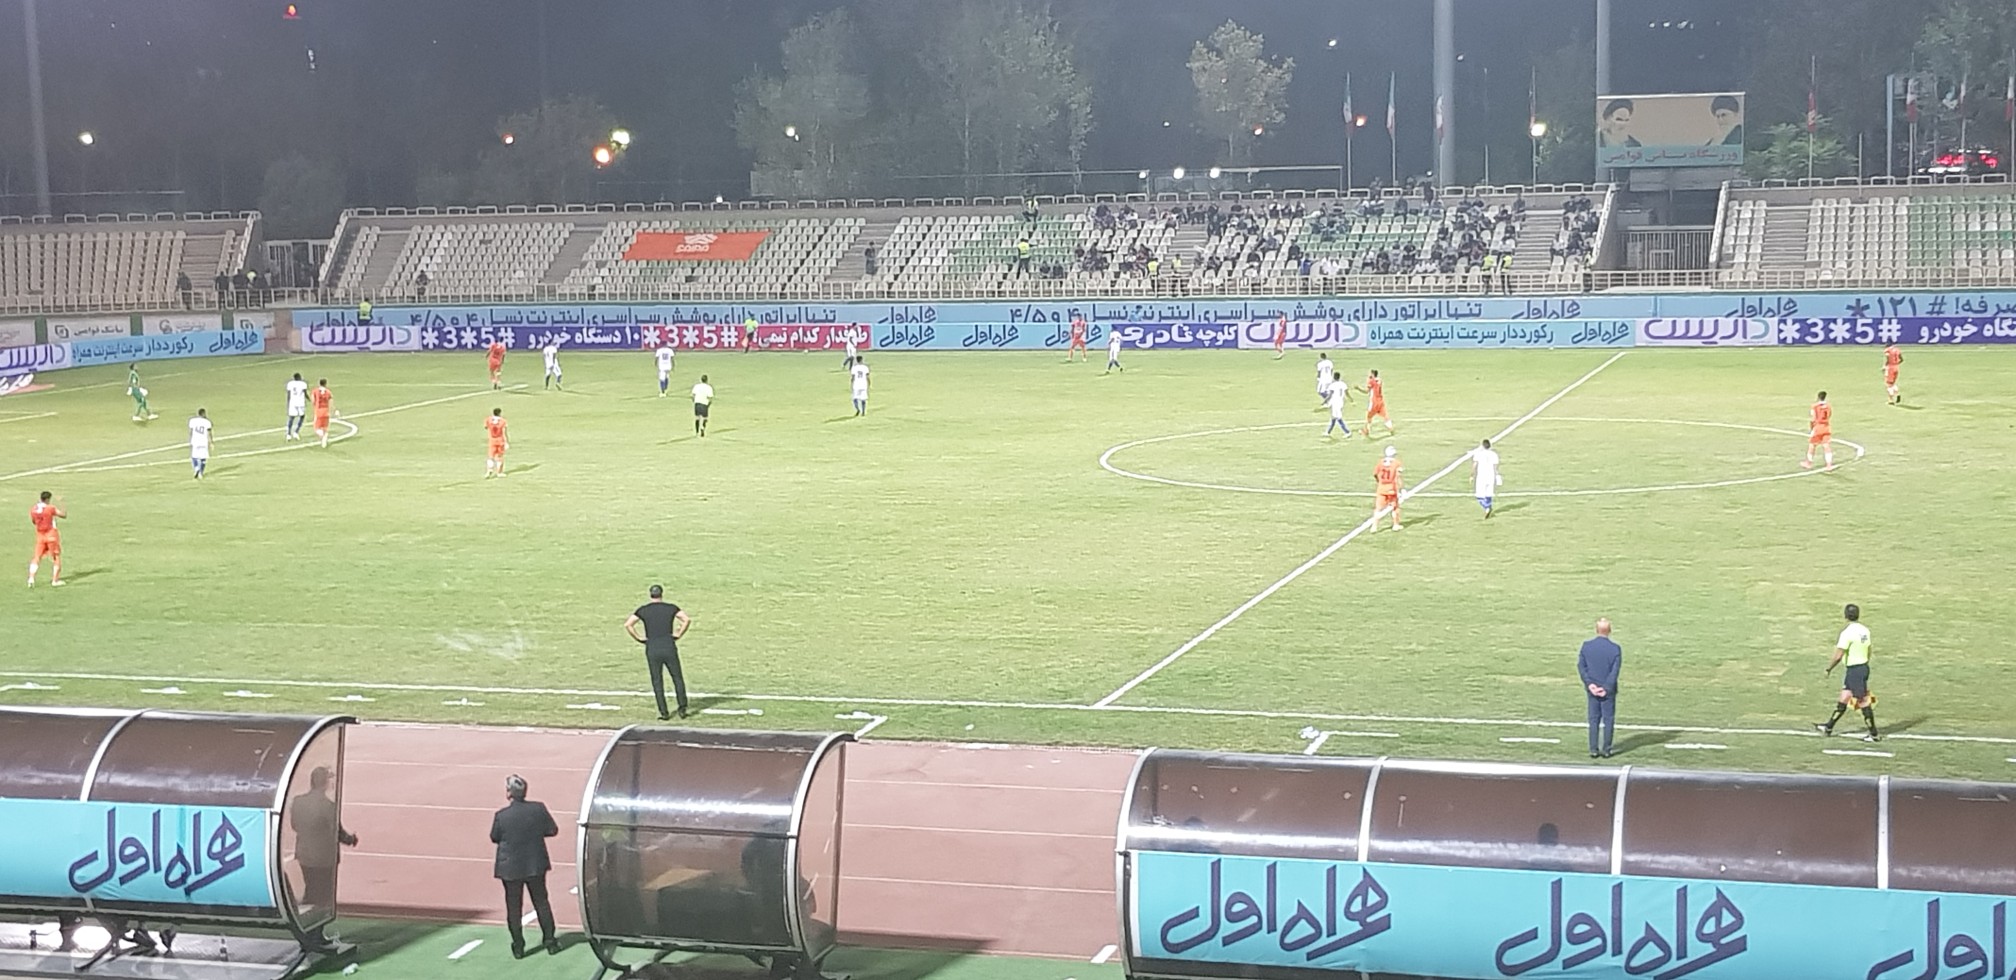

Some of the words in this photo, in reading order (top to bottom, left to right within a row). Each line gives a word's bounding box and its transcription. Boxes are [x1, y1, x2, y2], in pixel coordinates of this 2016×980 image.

[528, 326, 571, 349] خودرو
[575, 326, 622, 344] دستگاه
[791, 327, 820, 348] کدام
[1196, 324, 1238, 347] کلوچه
[1370, 325, 1403, 344] همراه
[1407, 325, 1454, 344] اینترنت
[1457, 327, 1497, 344] سرعت
[1918, 318, 1979, 343] خودرو
[69, 806, 162, 893] اول
[1160, 858, 1277, 954] اول
[1495, 877, 1623, 977] اول
